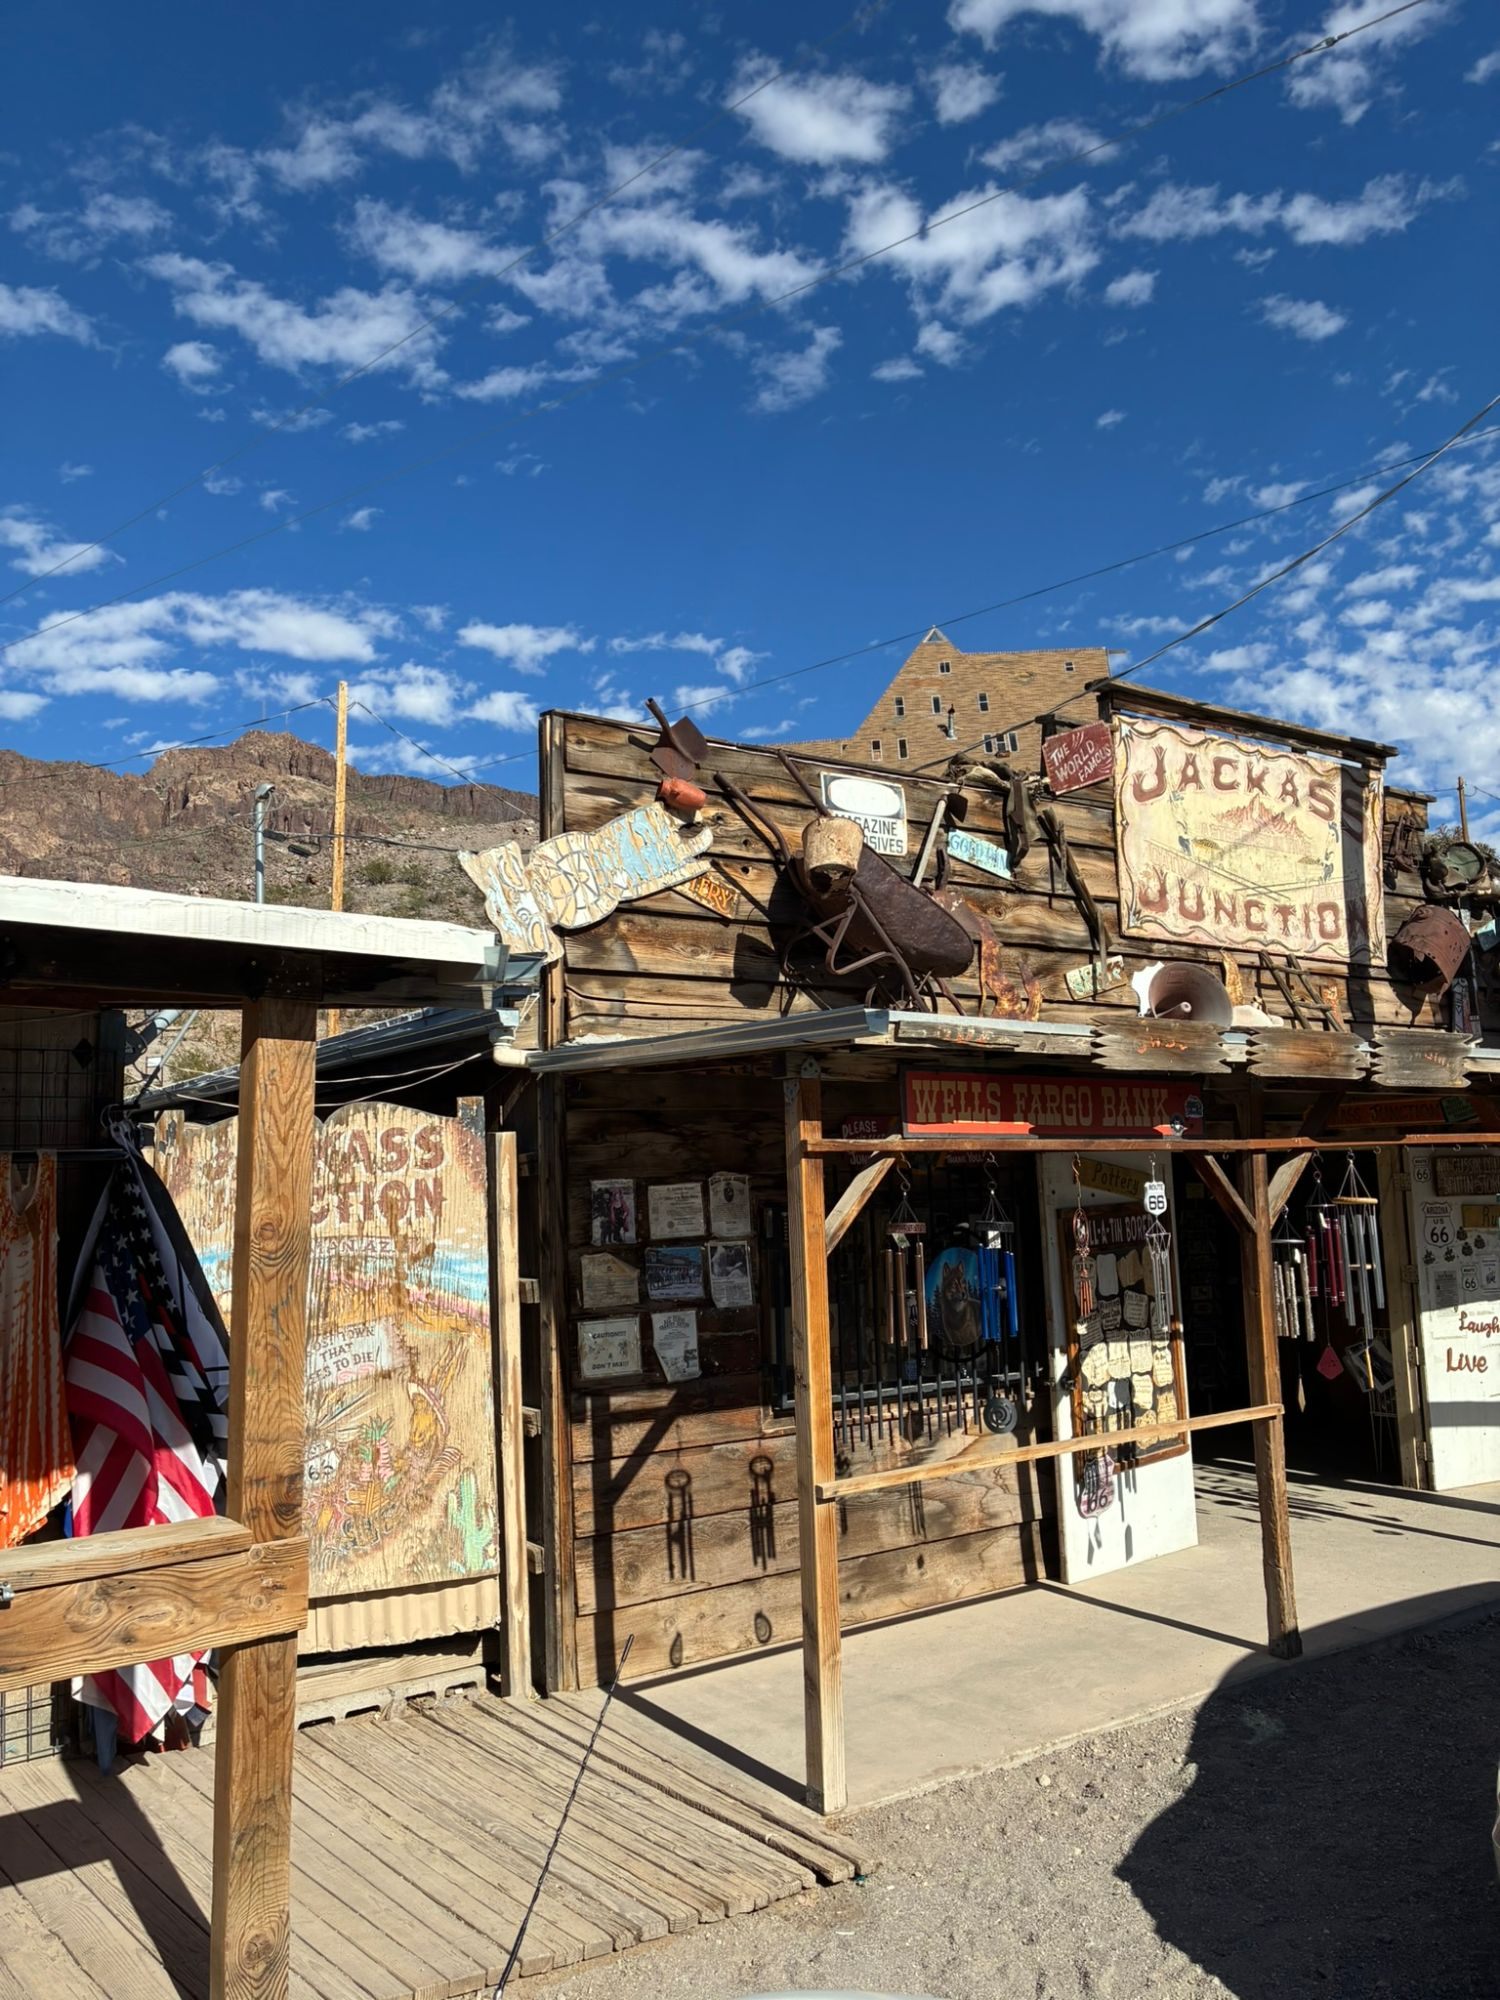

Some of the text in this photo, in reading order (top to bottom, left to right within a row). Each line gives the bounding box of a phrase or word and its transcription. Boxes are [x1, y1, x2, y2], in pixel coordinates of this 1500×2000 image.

[1051, 742, 1070, 767] THE
[1055, 740, 1095, 782] WORLD
[1078, 743, 1111, 782] FAMOUS
[1132, 745, 1366, 845] JACKASS
[1138, 864, 1367, 945] JUNCTION
[912, 1079, 1170, 1128] WELLS FARGO BANK
[1094, 1163, 1140, 1195] Pottery
[1416, 1168, 1429, 1180] 66
[1148, 1195, 1165, 1210] 66
[1426, 1205, 1449, 1215] ARIZONA
[1430, 1226, 1449, 1243] 66
[1465, 1278, 1477, 1289] 66
[338, 1324, 376, 1342] TOWN
[1459, 1311, 1500, 1338] Laugh
[319, 1342, 354, 1362] THAT
[333, 1357, 350, 1372] TO
[353, 1345, 381, 1365] DIE!
[1447, 1347, 1488, 1373] Live
[1089, 1486, 1108, 1512] 66
